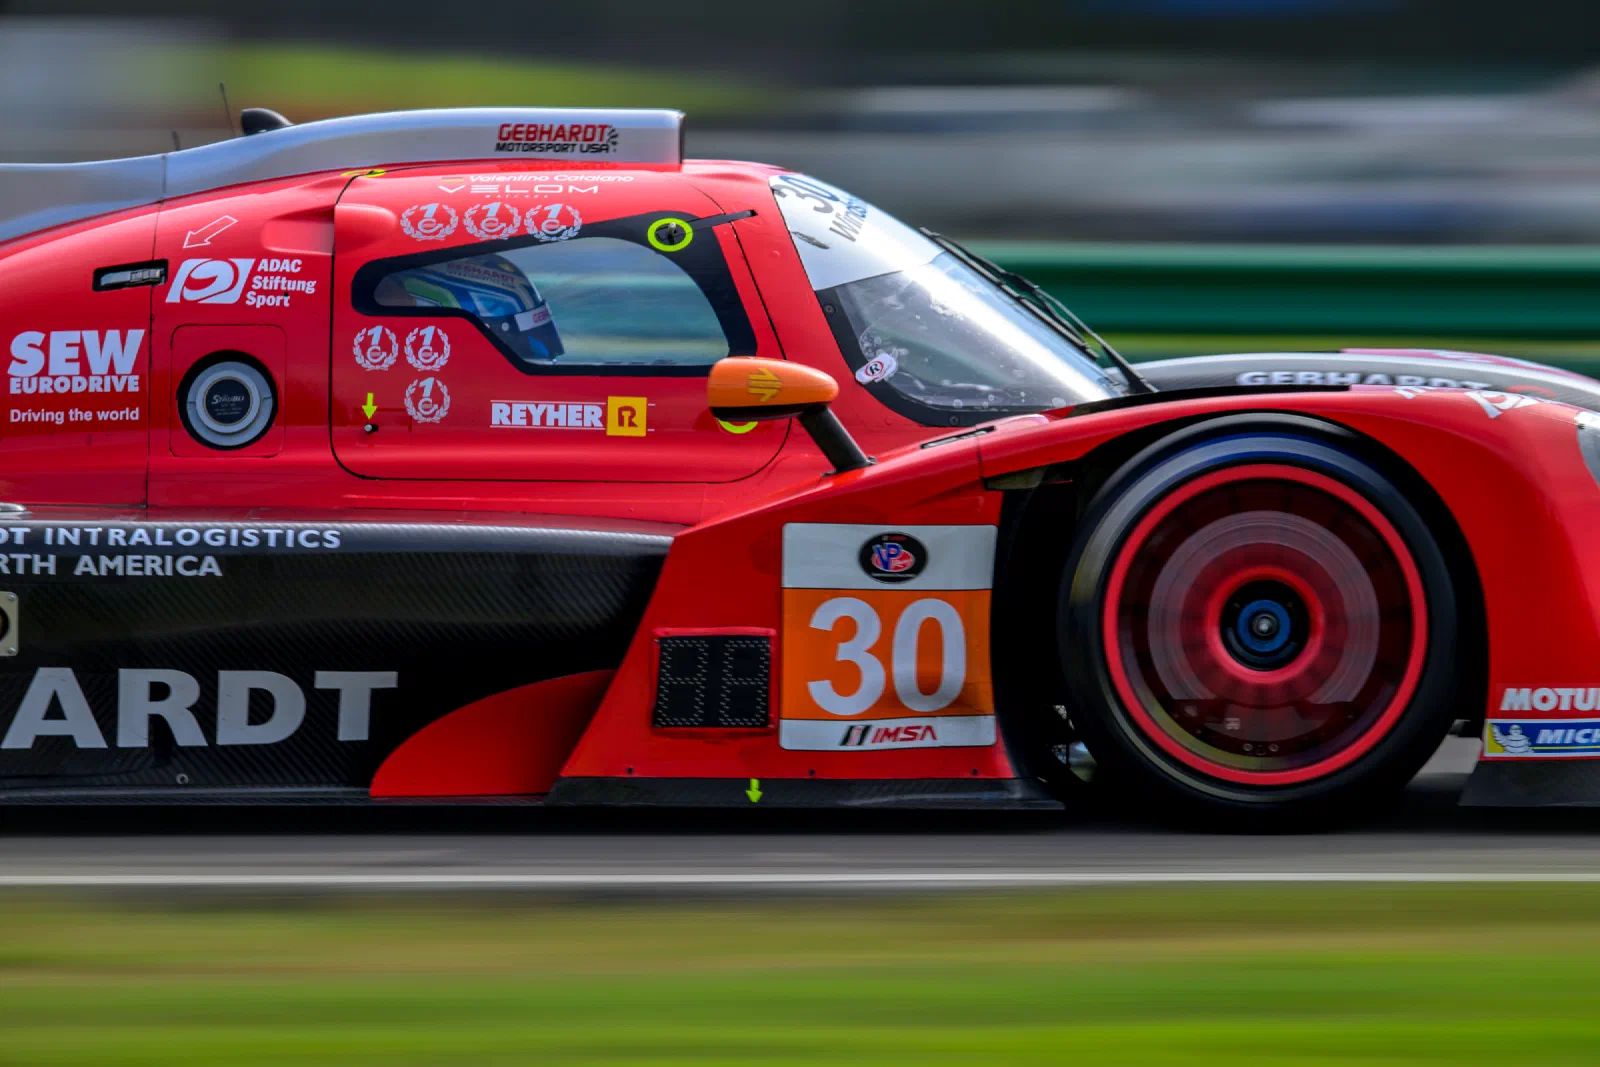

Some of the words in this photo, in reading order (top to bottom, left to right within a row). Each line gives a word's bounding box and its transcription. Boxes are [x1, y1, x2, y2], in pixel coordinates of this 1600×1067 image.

[498, 123, 609, 142] GEBHARDT
[494, 142, 577, 153] MOTORSPORT
[580, 143, 611, 154] USA
[469, 174, 549, 183] Valentino
[553, 173, 634, 182] Catalano
[437, 184, 599, 195] VELOM
[257, 259, 302, 273] ADAC
[251, 275, 316, 294] Stiftung
[245, 290, 290, 308] Sport
[7, 329, 145, 377] SEW
[9, 375, 140, 394] EURODRIVE
[10, 409, 65, 424] Driving
[69, 409, 93, 421] the
[97, 408, 140, 421] world
[491, 402, 603, 427] REYHER
[44, 527, 342, 549] INTRALOGISTICS
[74, 555, 223, 577] AMERICA
[808, 597, 967, 716] 30
[1, 667, 399, 749] ARDT
[1500, 687, 1600, 711] MOTU
[871, 725, 937, 744] IMSA
